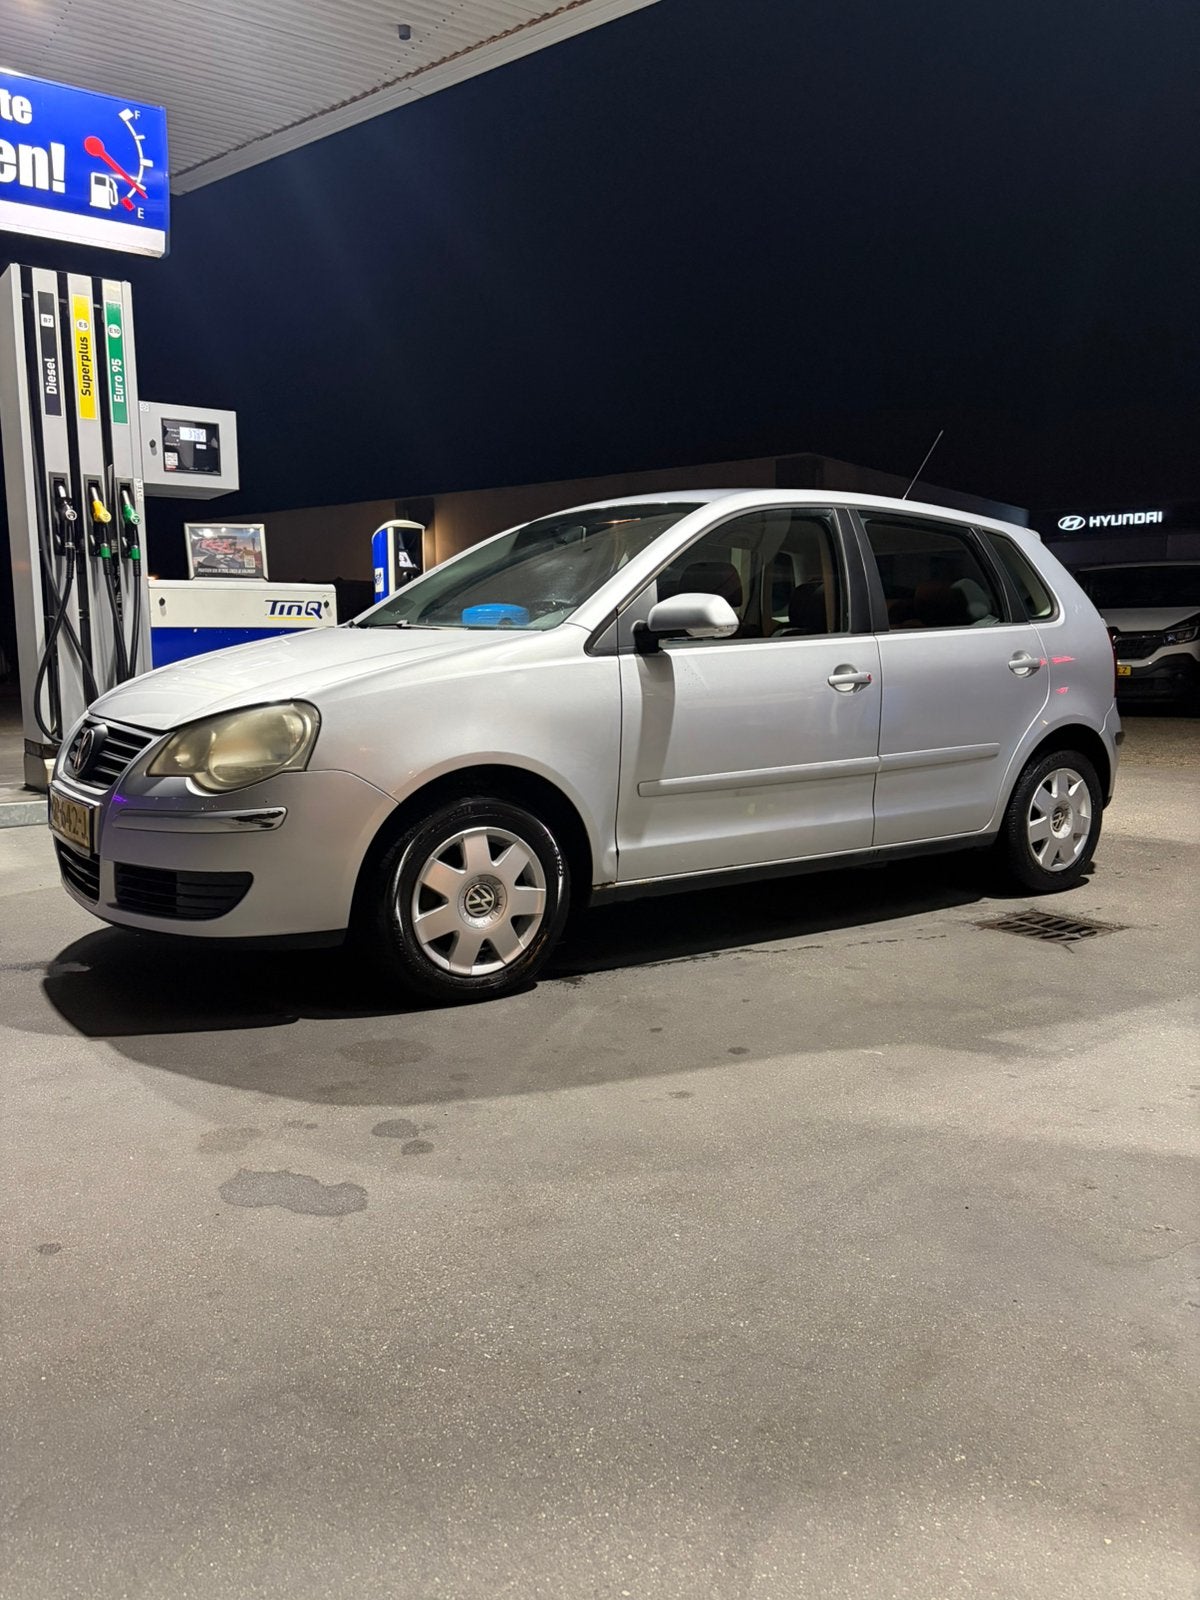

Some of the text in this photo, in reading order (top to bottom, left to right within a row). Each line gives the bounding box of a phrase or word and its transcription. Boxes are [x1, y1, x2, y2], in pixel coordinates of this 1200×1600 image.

[134, 110, 141, 120] F
[137, 207, 145, 219] E
[109, 327, 120, 335] E10
[78, 336, 91, 396] Superplus
[44, 357, 58, 394] Diesel
[111, 357, 124, 403] Euro 95
[1089, 511, 1163, 527] HYUNDAI
